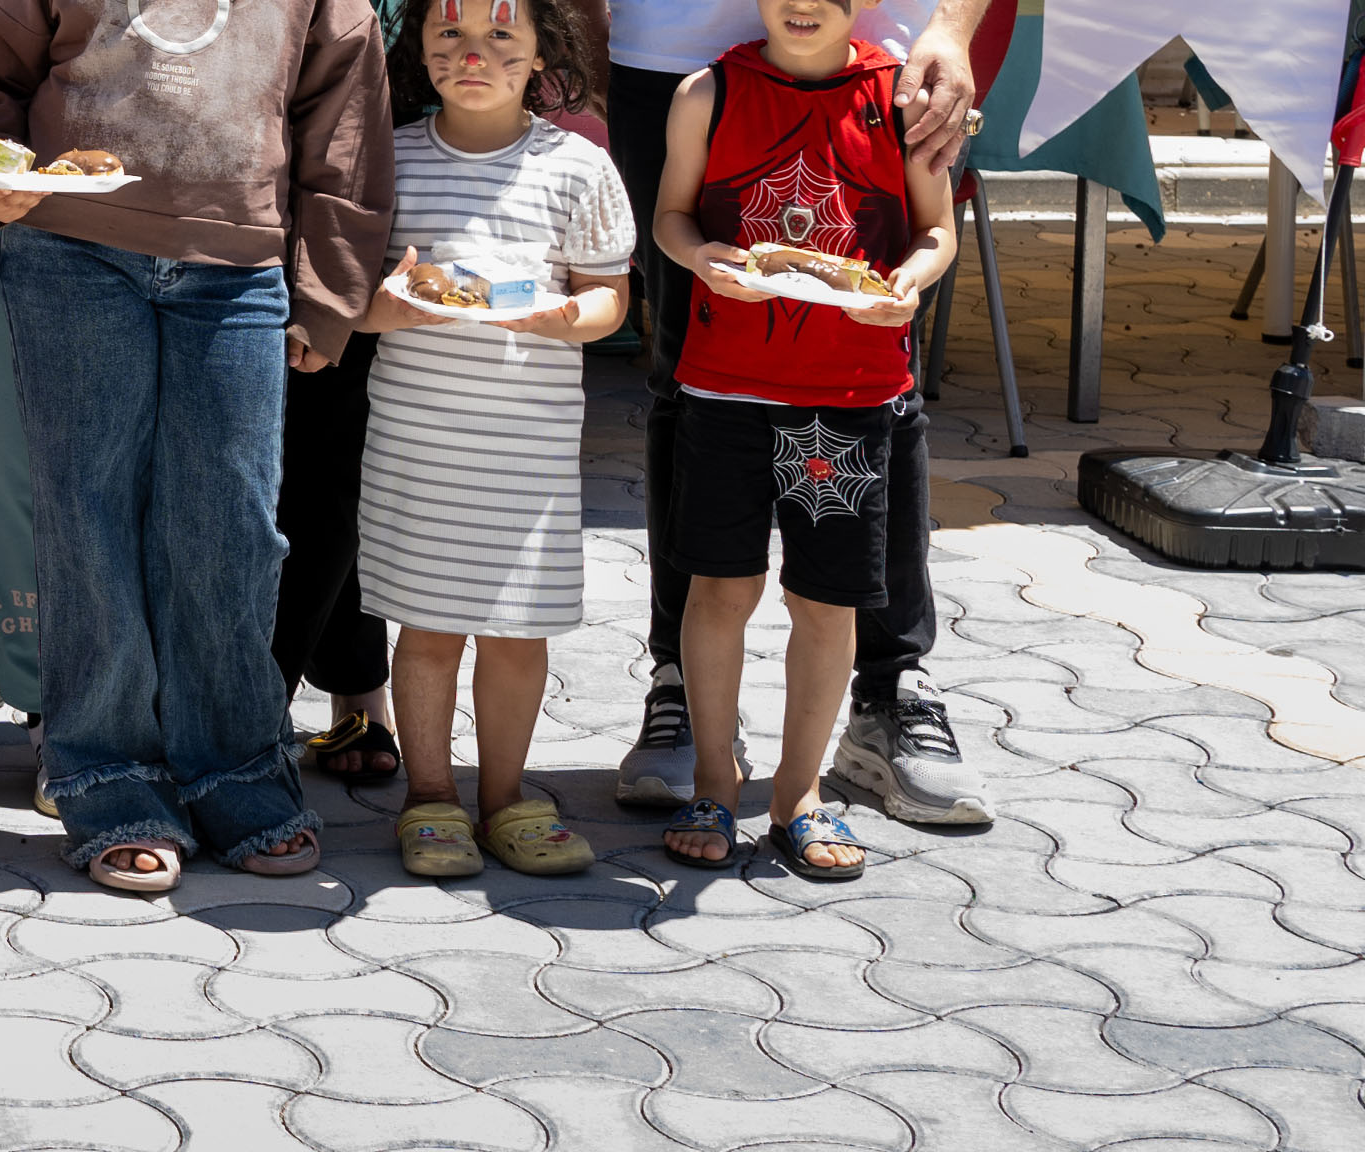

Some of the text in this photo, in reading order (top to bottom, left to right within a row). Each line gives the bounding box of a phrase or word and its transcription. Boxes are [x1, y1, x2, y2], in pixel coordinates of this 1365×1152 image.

[152, 61, 196, 75] BE SOMEBODY
[145, 71, 200, 86] NOBODY THOUGHT
[147, 81, 159, 91] YOU
[161, 84, 182, 94] COULD
